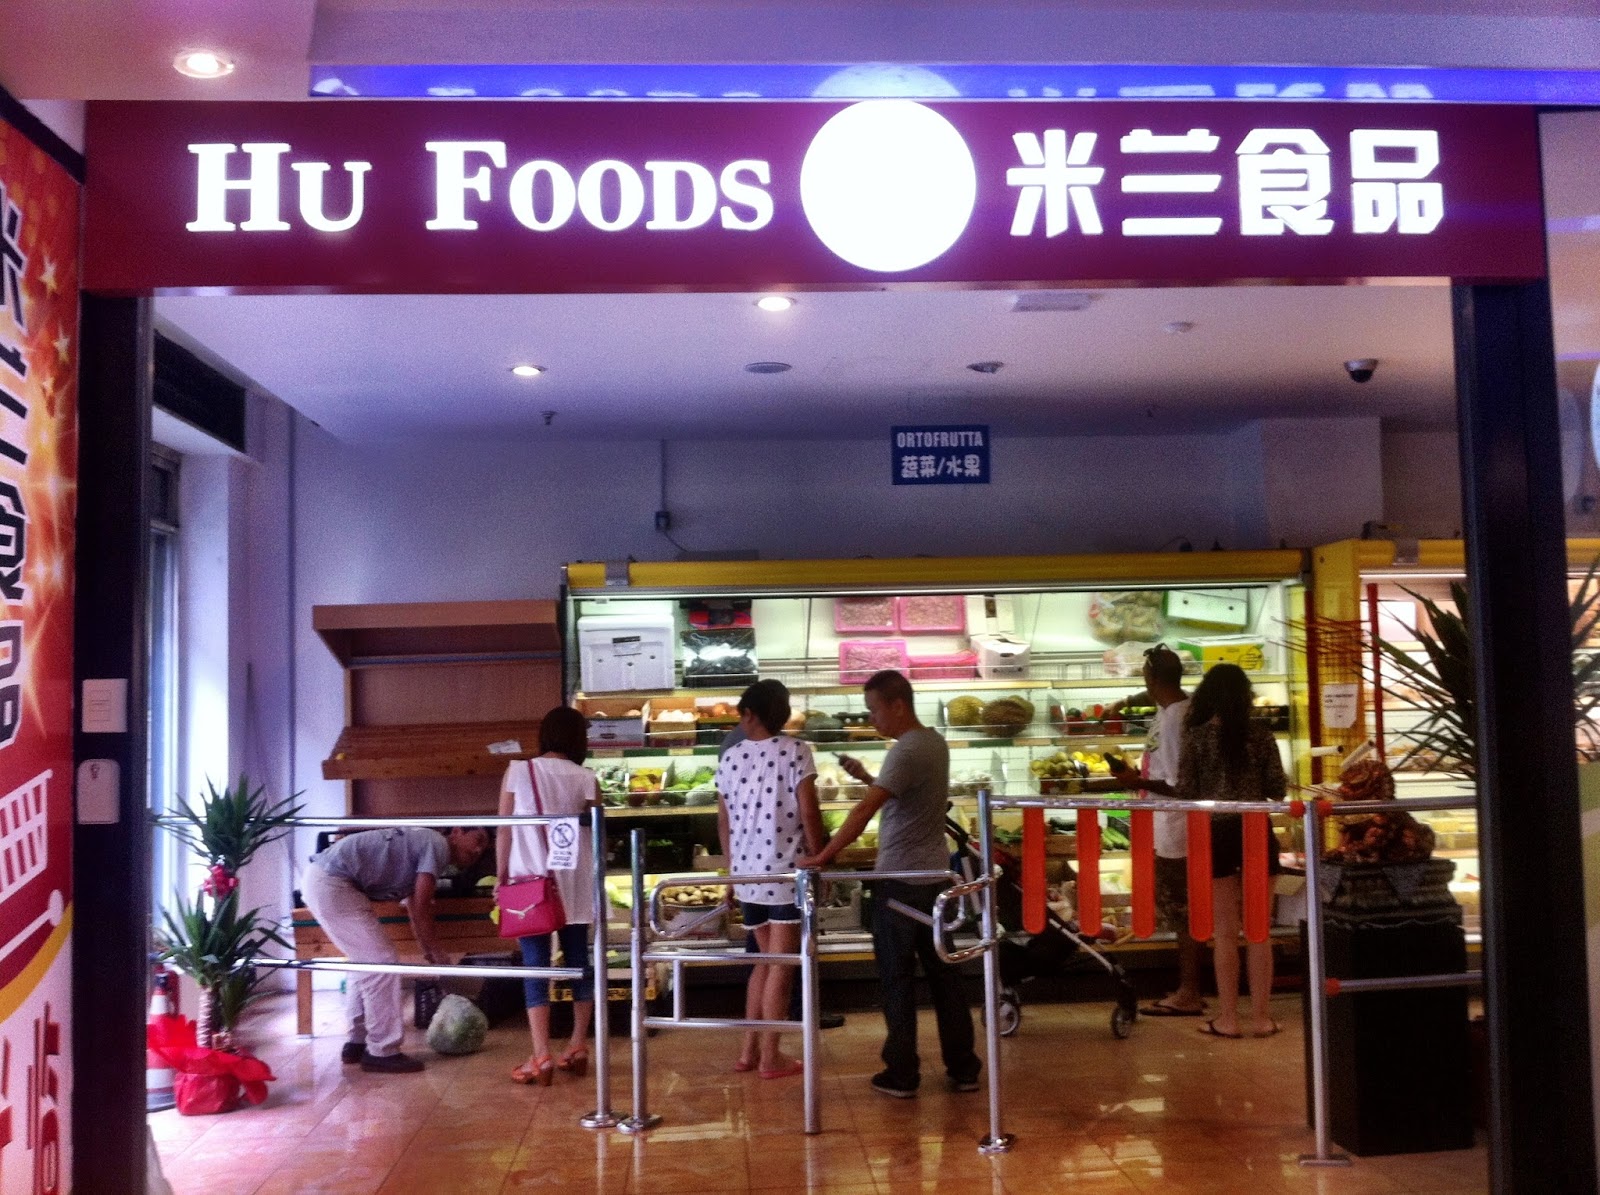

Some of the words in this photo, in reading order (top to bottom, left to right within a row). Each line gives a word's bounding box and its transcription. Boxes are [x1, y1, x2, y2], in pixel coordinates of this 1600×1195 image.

[1006, 128, 1444, 237] 米兰食品
[896, 431, 983, 447] ORTOFRUTTA
[901, 454, 980, 478] 蔬菜/水果
